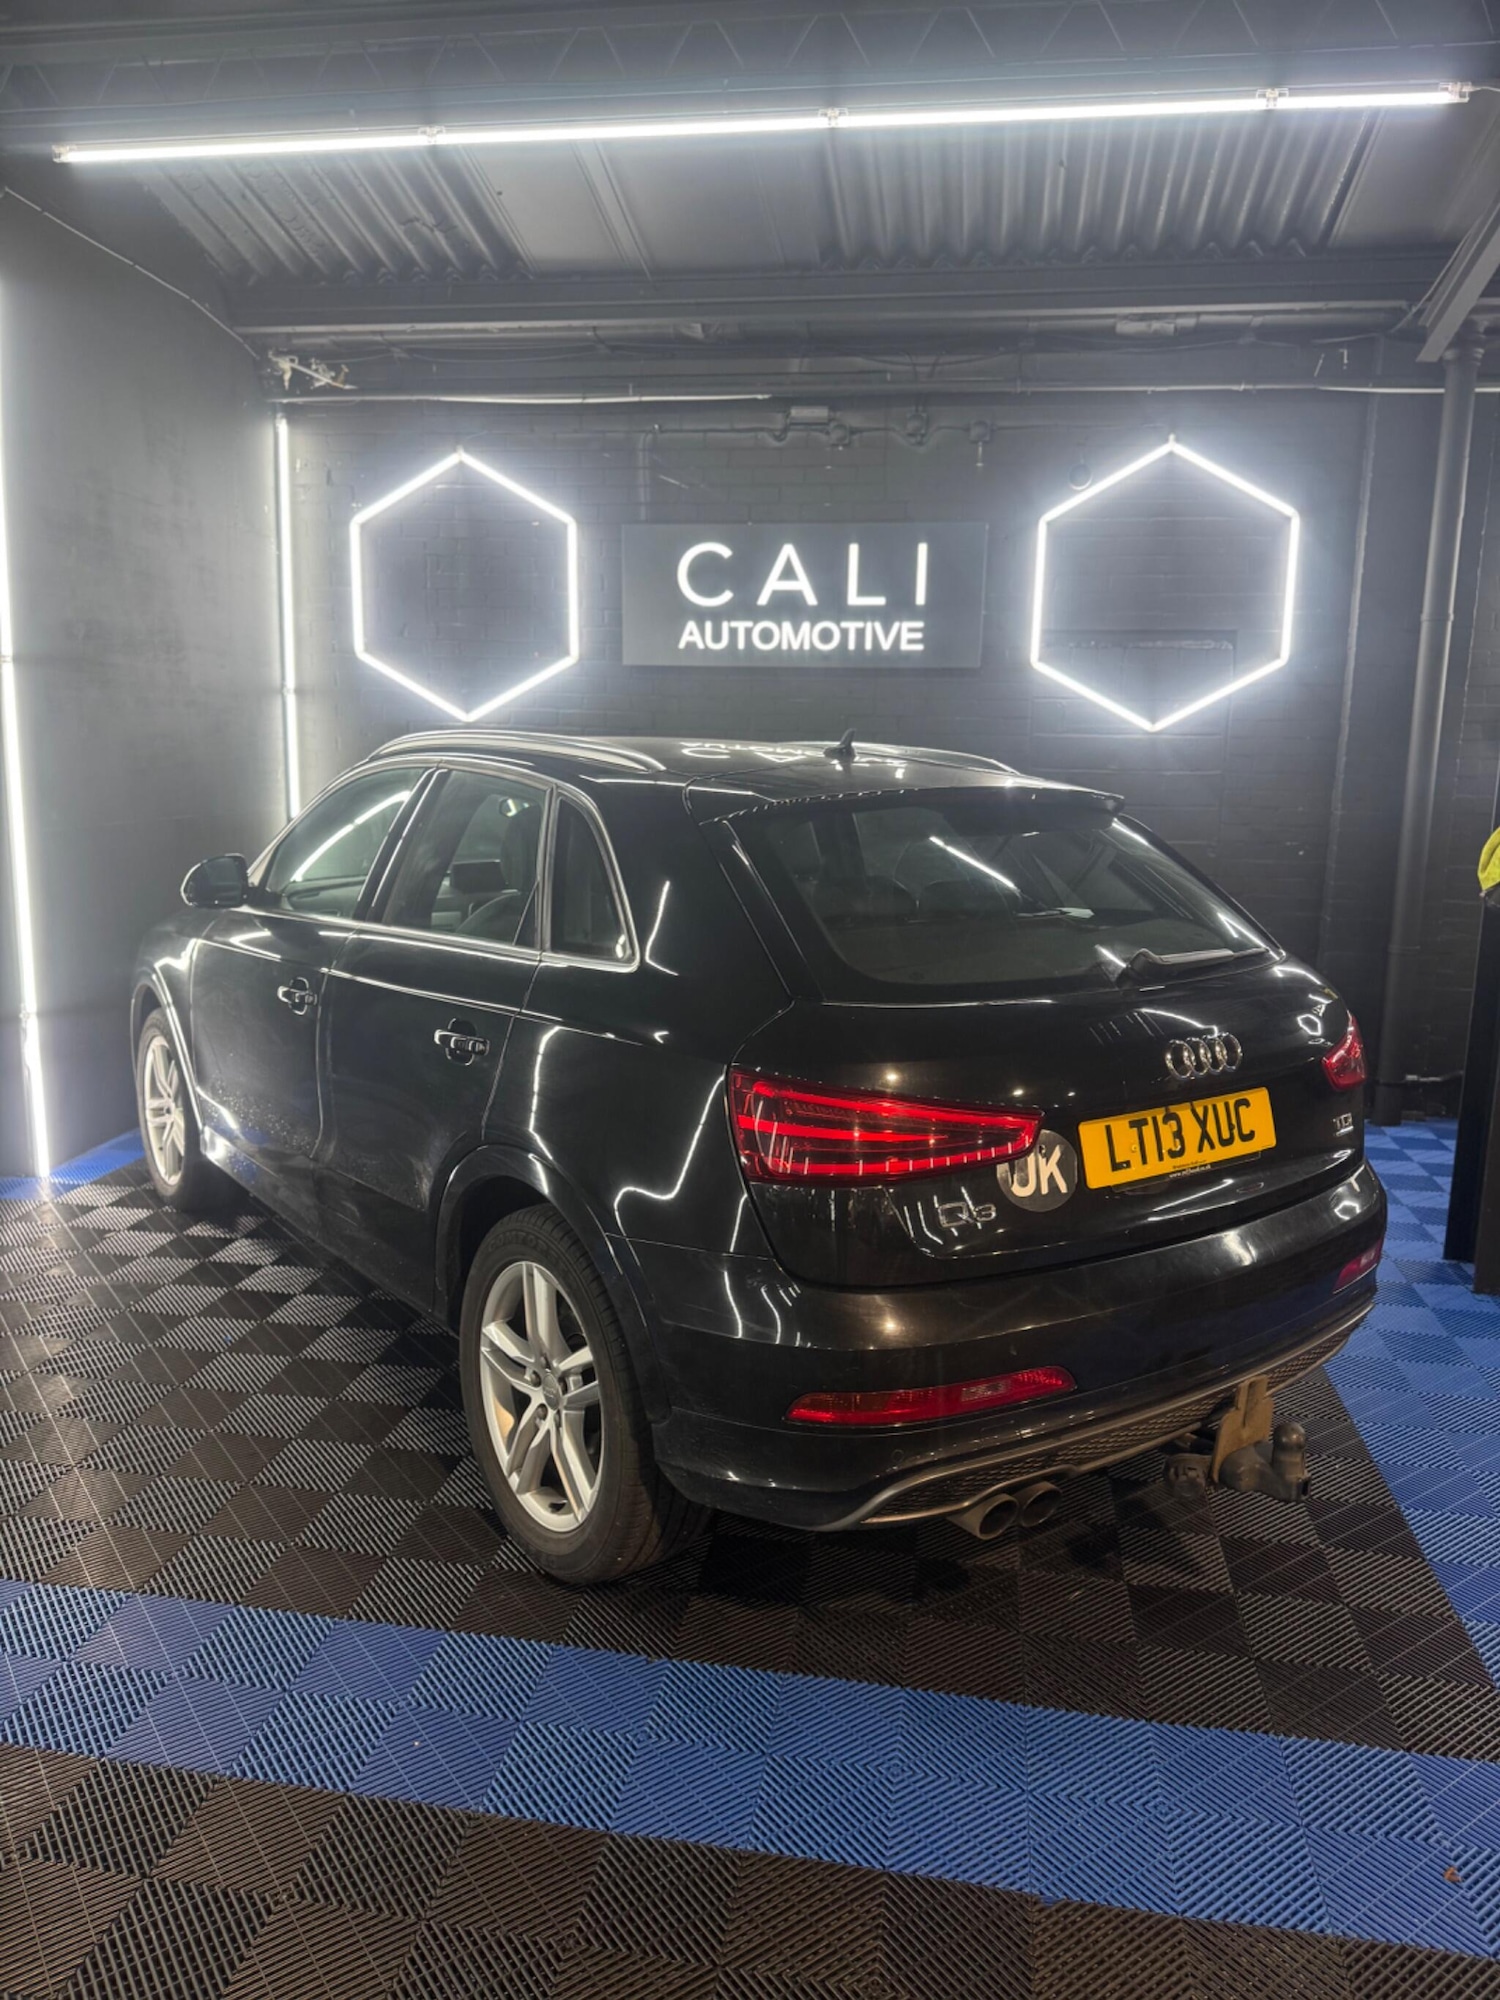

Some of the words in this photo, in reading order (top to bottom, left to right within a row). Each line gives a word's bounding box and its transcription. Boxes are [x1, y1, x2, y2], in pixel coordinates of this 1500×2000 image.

[677, 542, 928, 607] CALI
[678, 620, 925, 651] AUTOMOTIVE
[1104, 1111, 1186, 1173] LT13
[1190, 1097, 1256, 1153] XUC
[1010, 1144, 1069, 1198] UK
[937, 1201, 997, 1228] Q3
